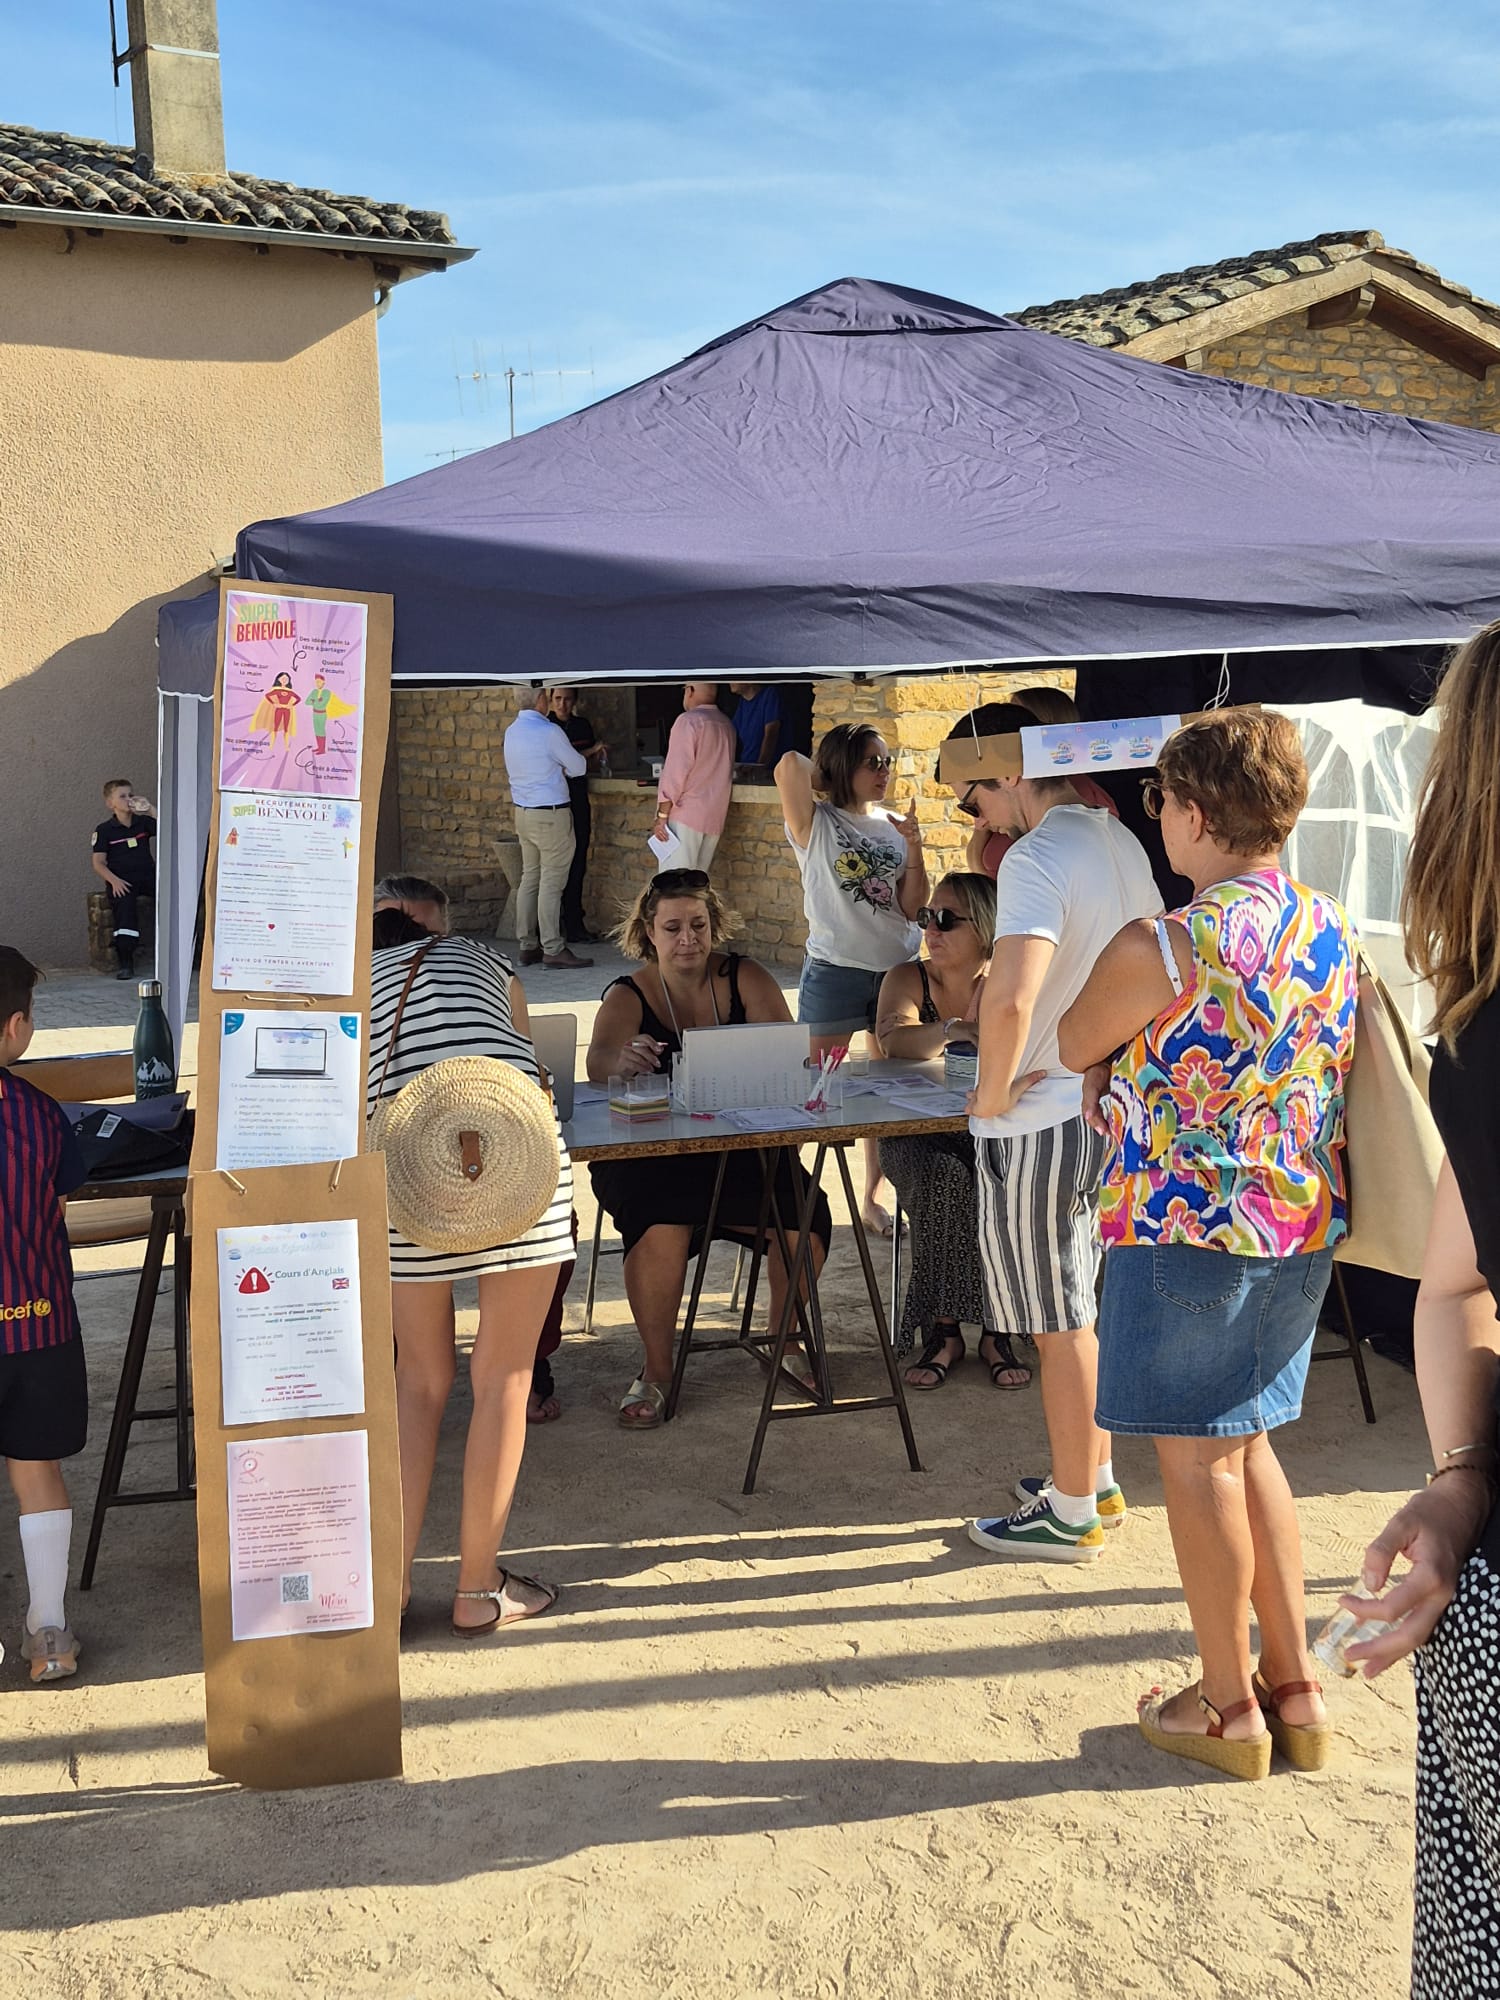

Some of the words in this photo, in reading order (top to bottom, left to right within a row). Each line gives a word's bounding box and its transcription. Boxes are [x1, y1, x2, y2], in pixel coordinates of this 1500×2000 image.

[240, 603, 279, 622] SUPER
[236, 620, 296, 642] BENEVOLE
[232, 804, 256, 817] SUPER
[255, 799, 317, 809] RECRUTEMENT
[275, 1270, 301, 1279] Cours
[303, 1265, 345, 1277] d'Anglais
